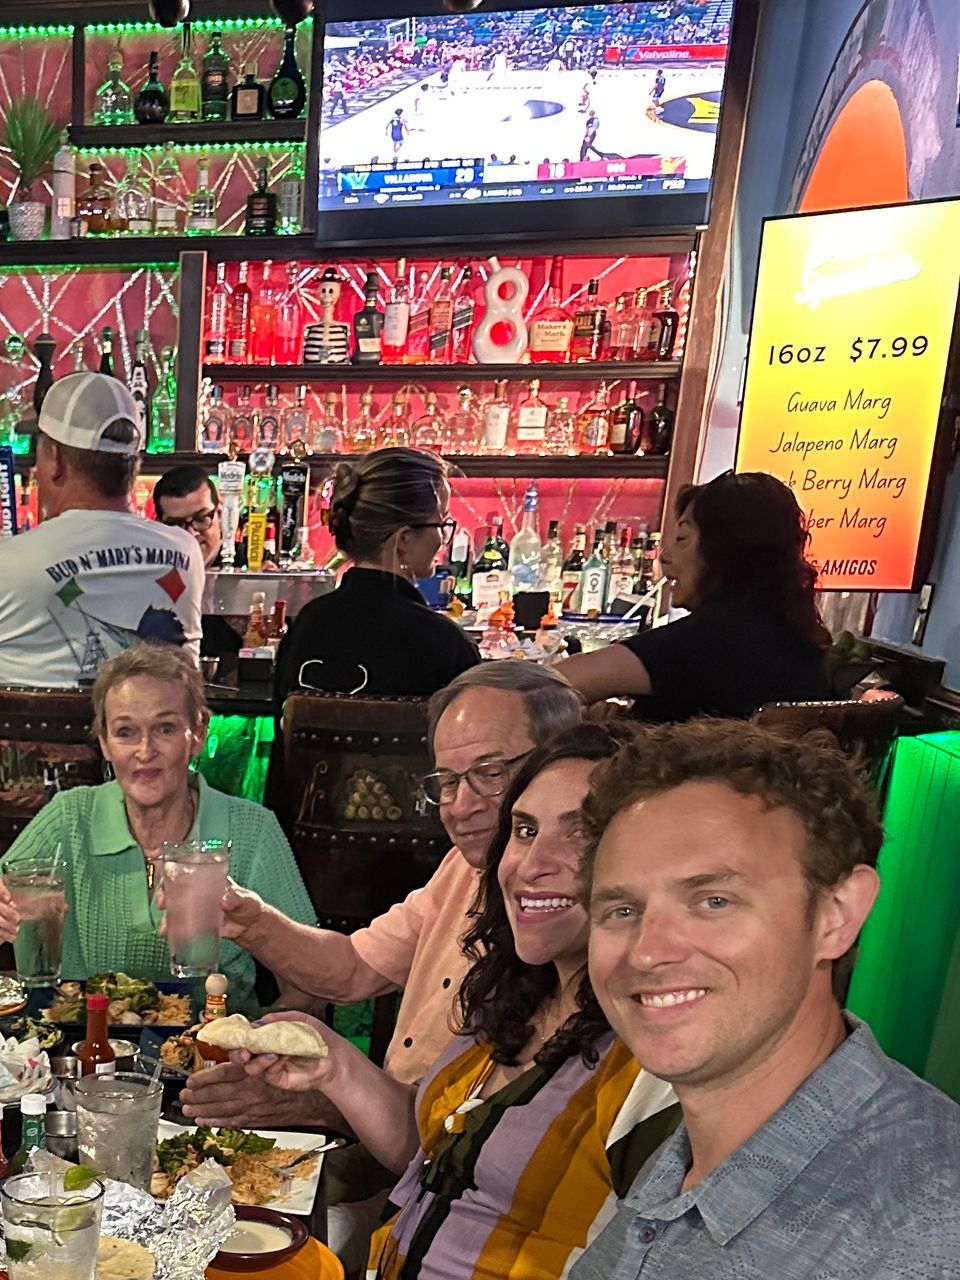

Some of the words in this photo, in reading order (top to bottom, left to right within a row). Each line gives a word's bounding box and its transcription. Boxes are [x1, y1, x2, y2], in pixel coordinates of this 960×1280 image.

[639, 50, 690, 59] Valvoline
[768, 344, 827, 366] 16oz
[849, 335, 929, 363] $7.99
[787, 391, 837, 413] Guava
[843, 388, 892, 419] Marg
[768, 431, 844, 461] Jalapeno
[849, 428, 898, 459] Marg
[802, 469, 852, 499] Berry
[858, 468, 907, 498] Marg
[839, 507, 887, 538] Marg
[44, 558, 80, 583] BUD
[96, 545, 144, 568] MARY'S
[820, 559, 878, 576] AMIGOS
[562, 582, 579, 609] 7
